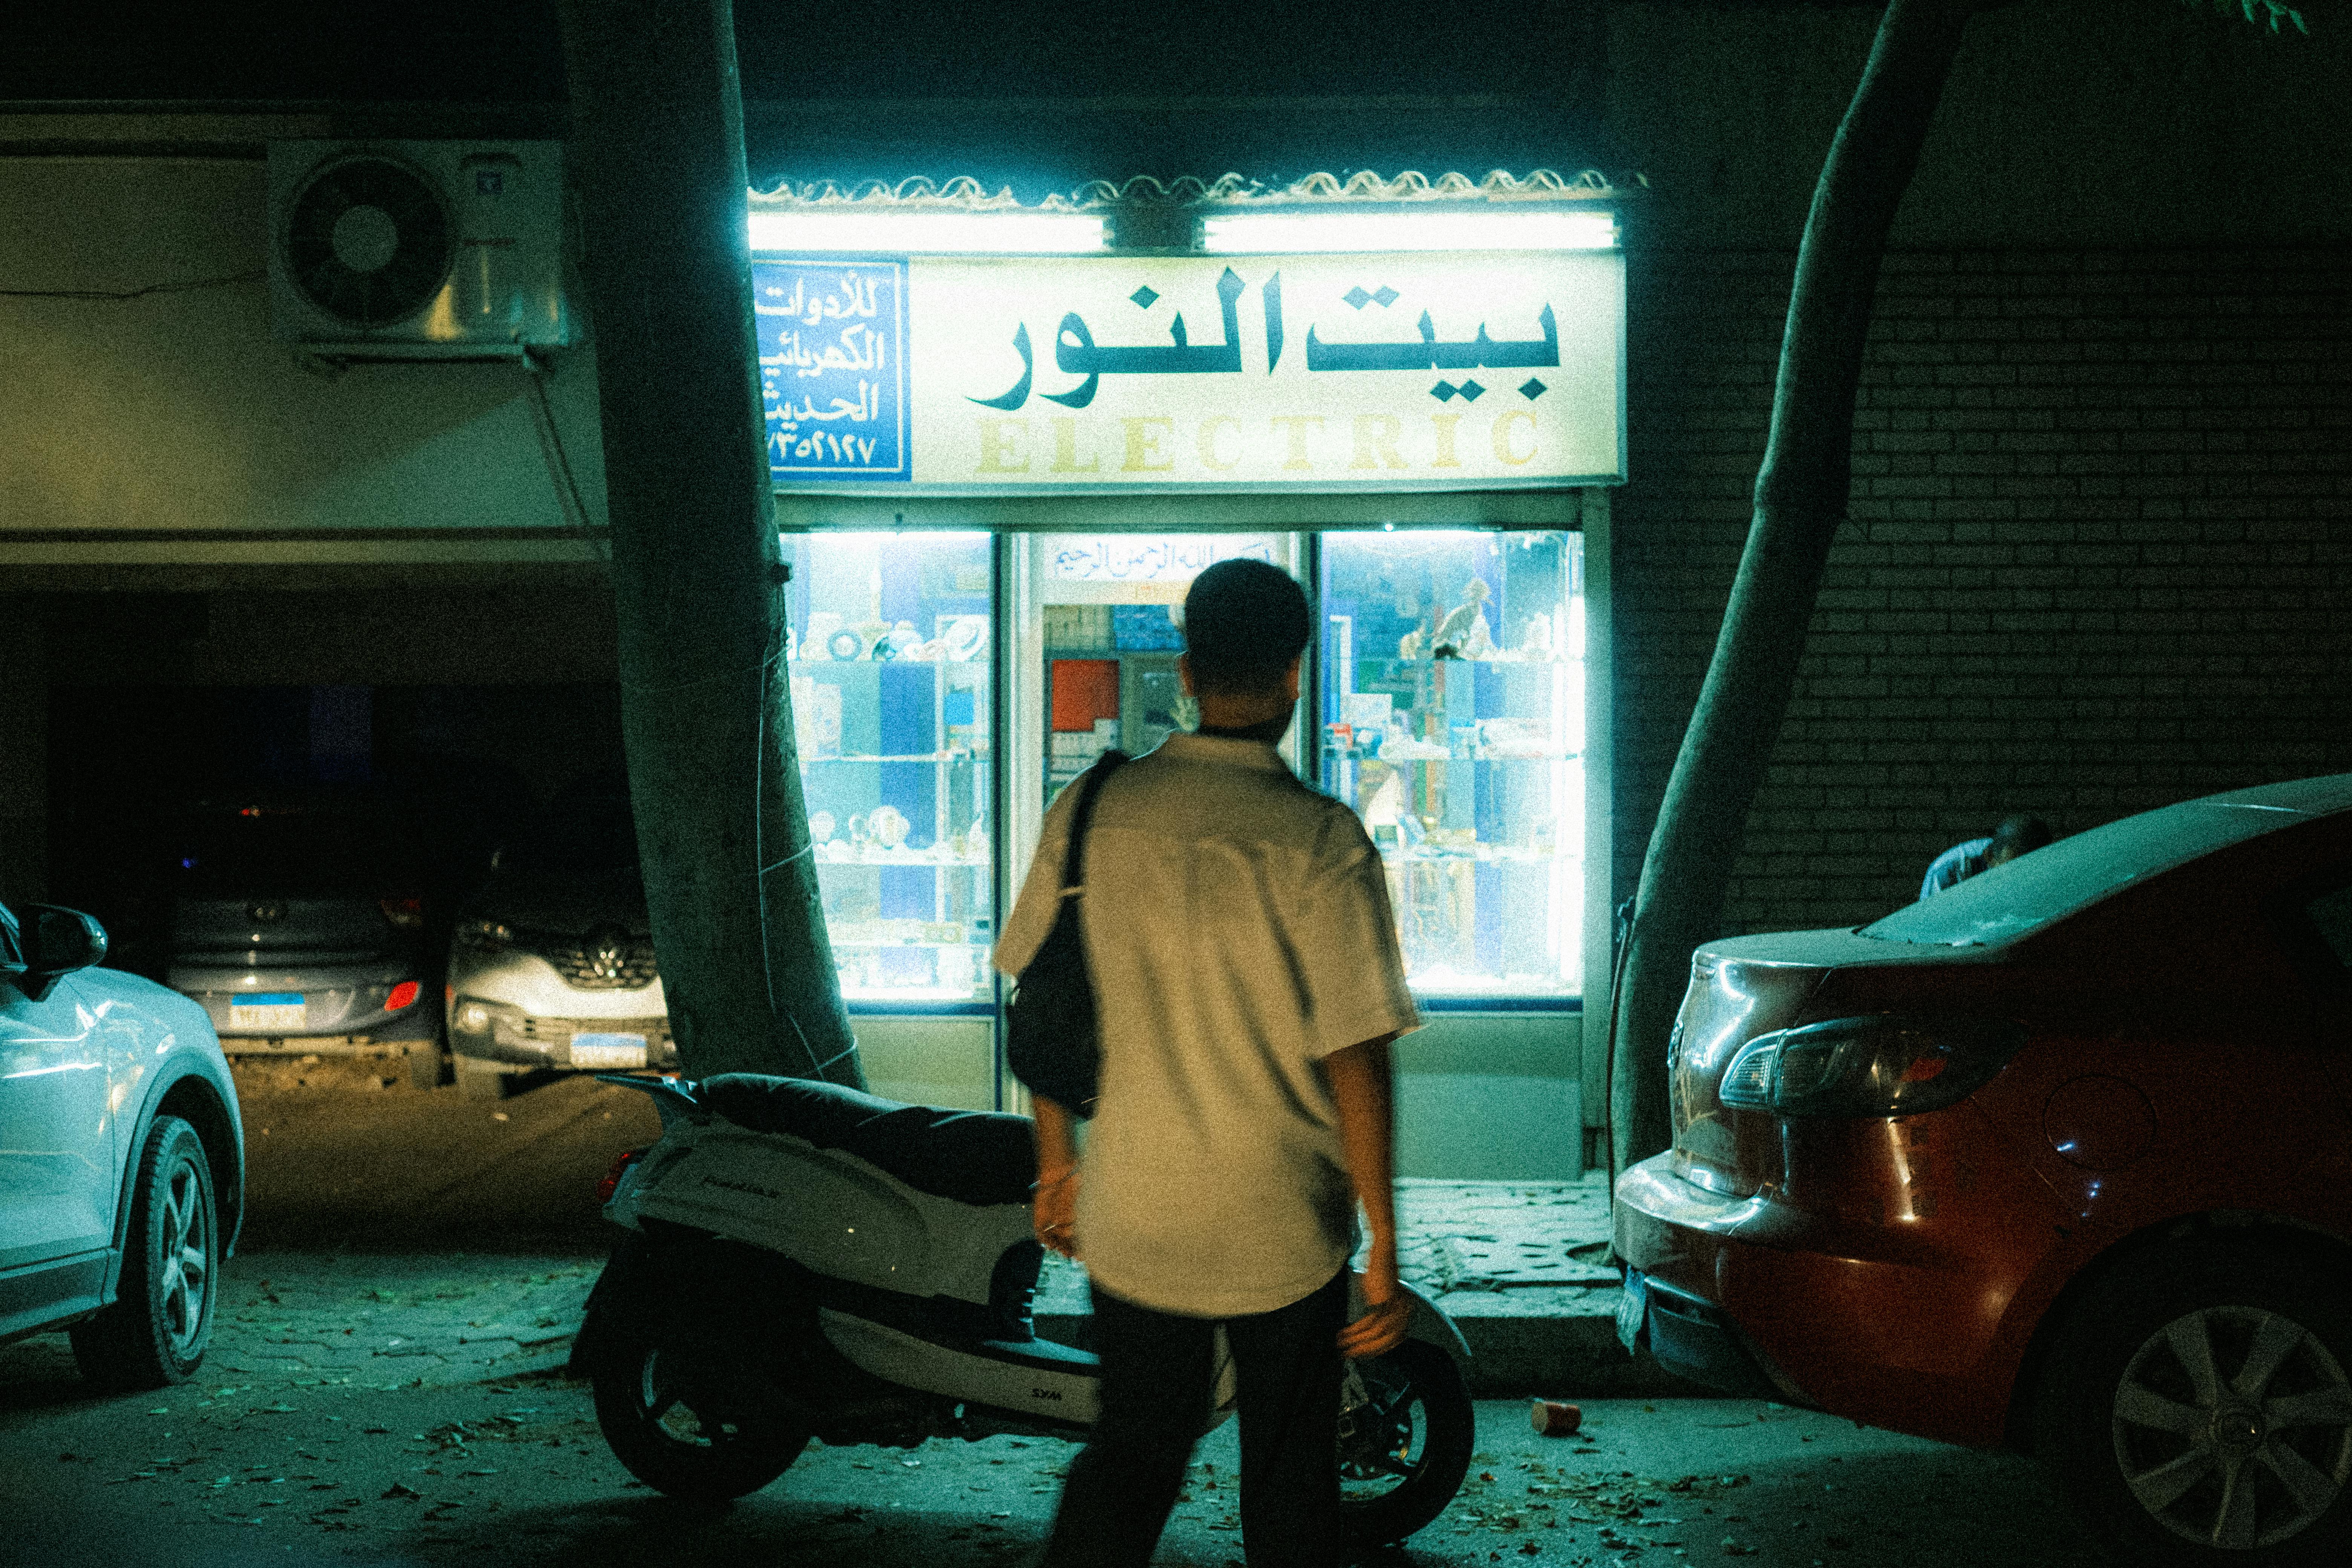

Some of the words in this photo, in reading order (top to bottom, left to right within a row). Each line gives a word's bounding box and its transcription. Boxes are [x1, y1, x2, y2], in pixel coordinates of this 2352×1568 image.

[754, 269, 877, 326] للأدوات
[759, 323, 885, 378] الكهربائي
[963, 265, 1283, 411] النور
[1306, 283, 1561, 403] بيت
[762, 378, 879, 431] الحديث
[974, 409, 1540, 474] ELECTRIC
[1031, 1387, 1062, 1401] SYM
